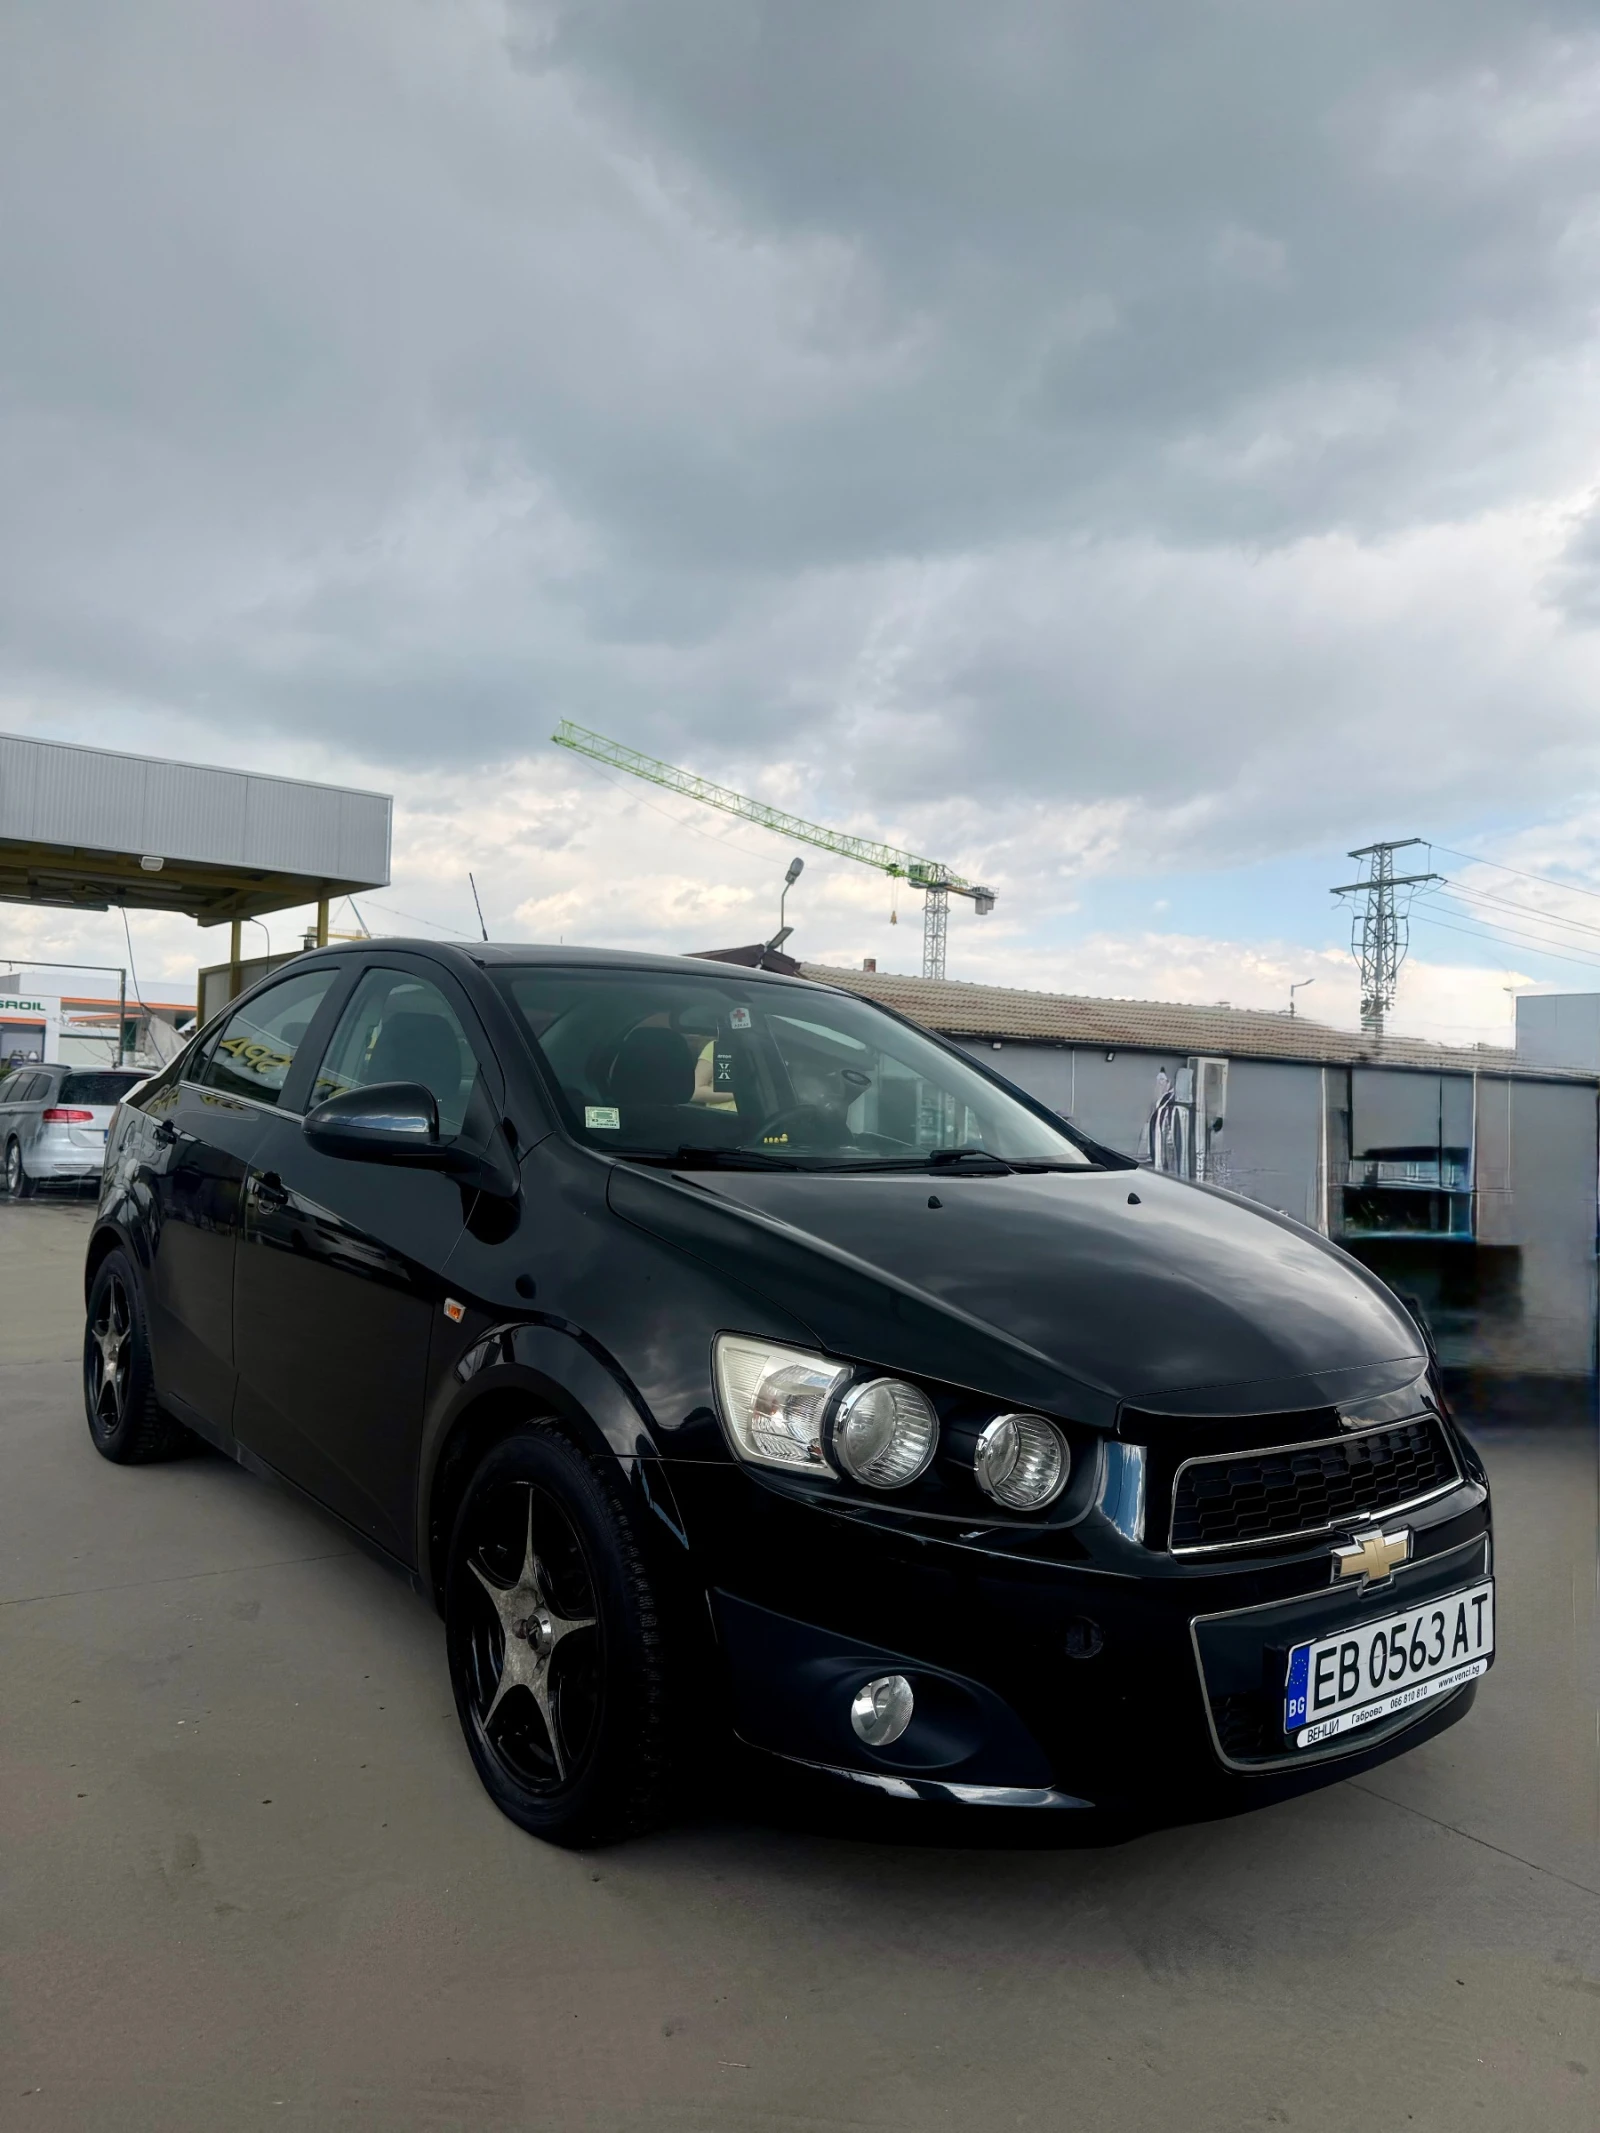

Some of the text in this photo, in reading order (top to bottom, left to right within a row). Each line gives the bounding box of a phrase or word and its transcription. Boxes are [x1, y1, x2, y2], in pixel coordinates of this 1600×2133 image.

[1313, 1593, 1488, 1711] EB 0563 AT
[1288, 1696, 1305, 1718] BG
[1307, 1665, 1480, 1744] ВЕНЦИ Габрово 066 810 810 www.venci.bg
